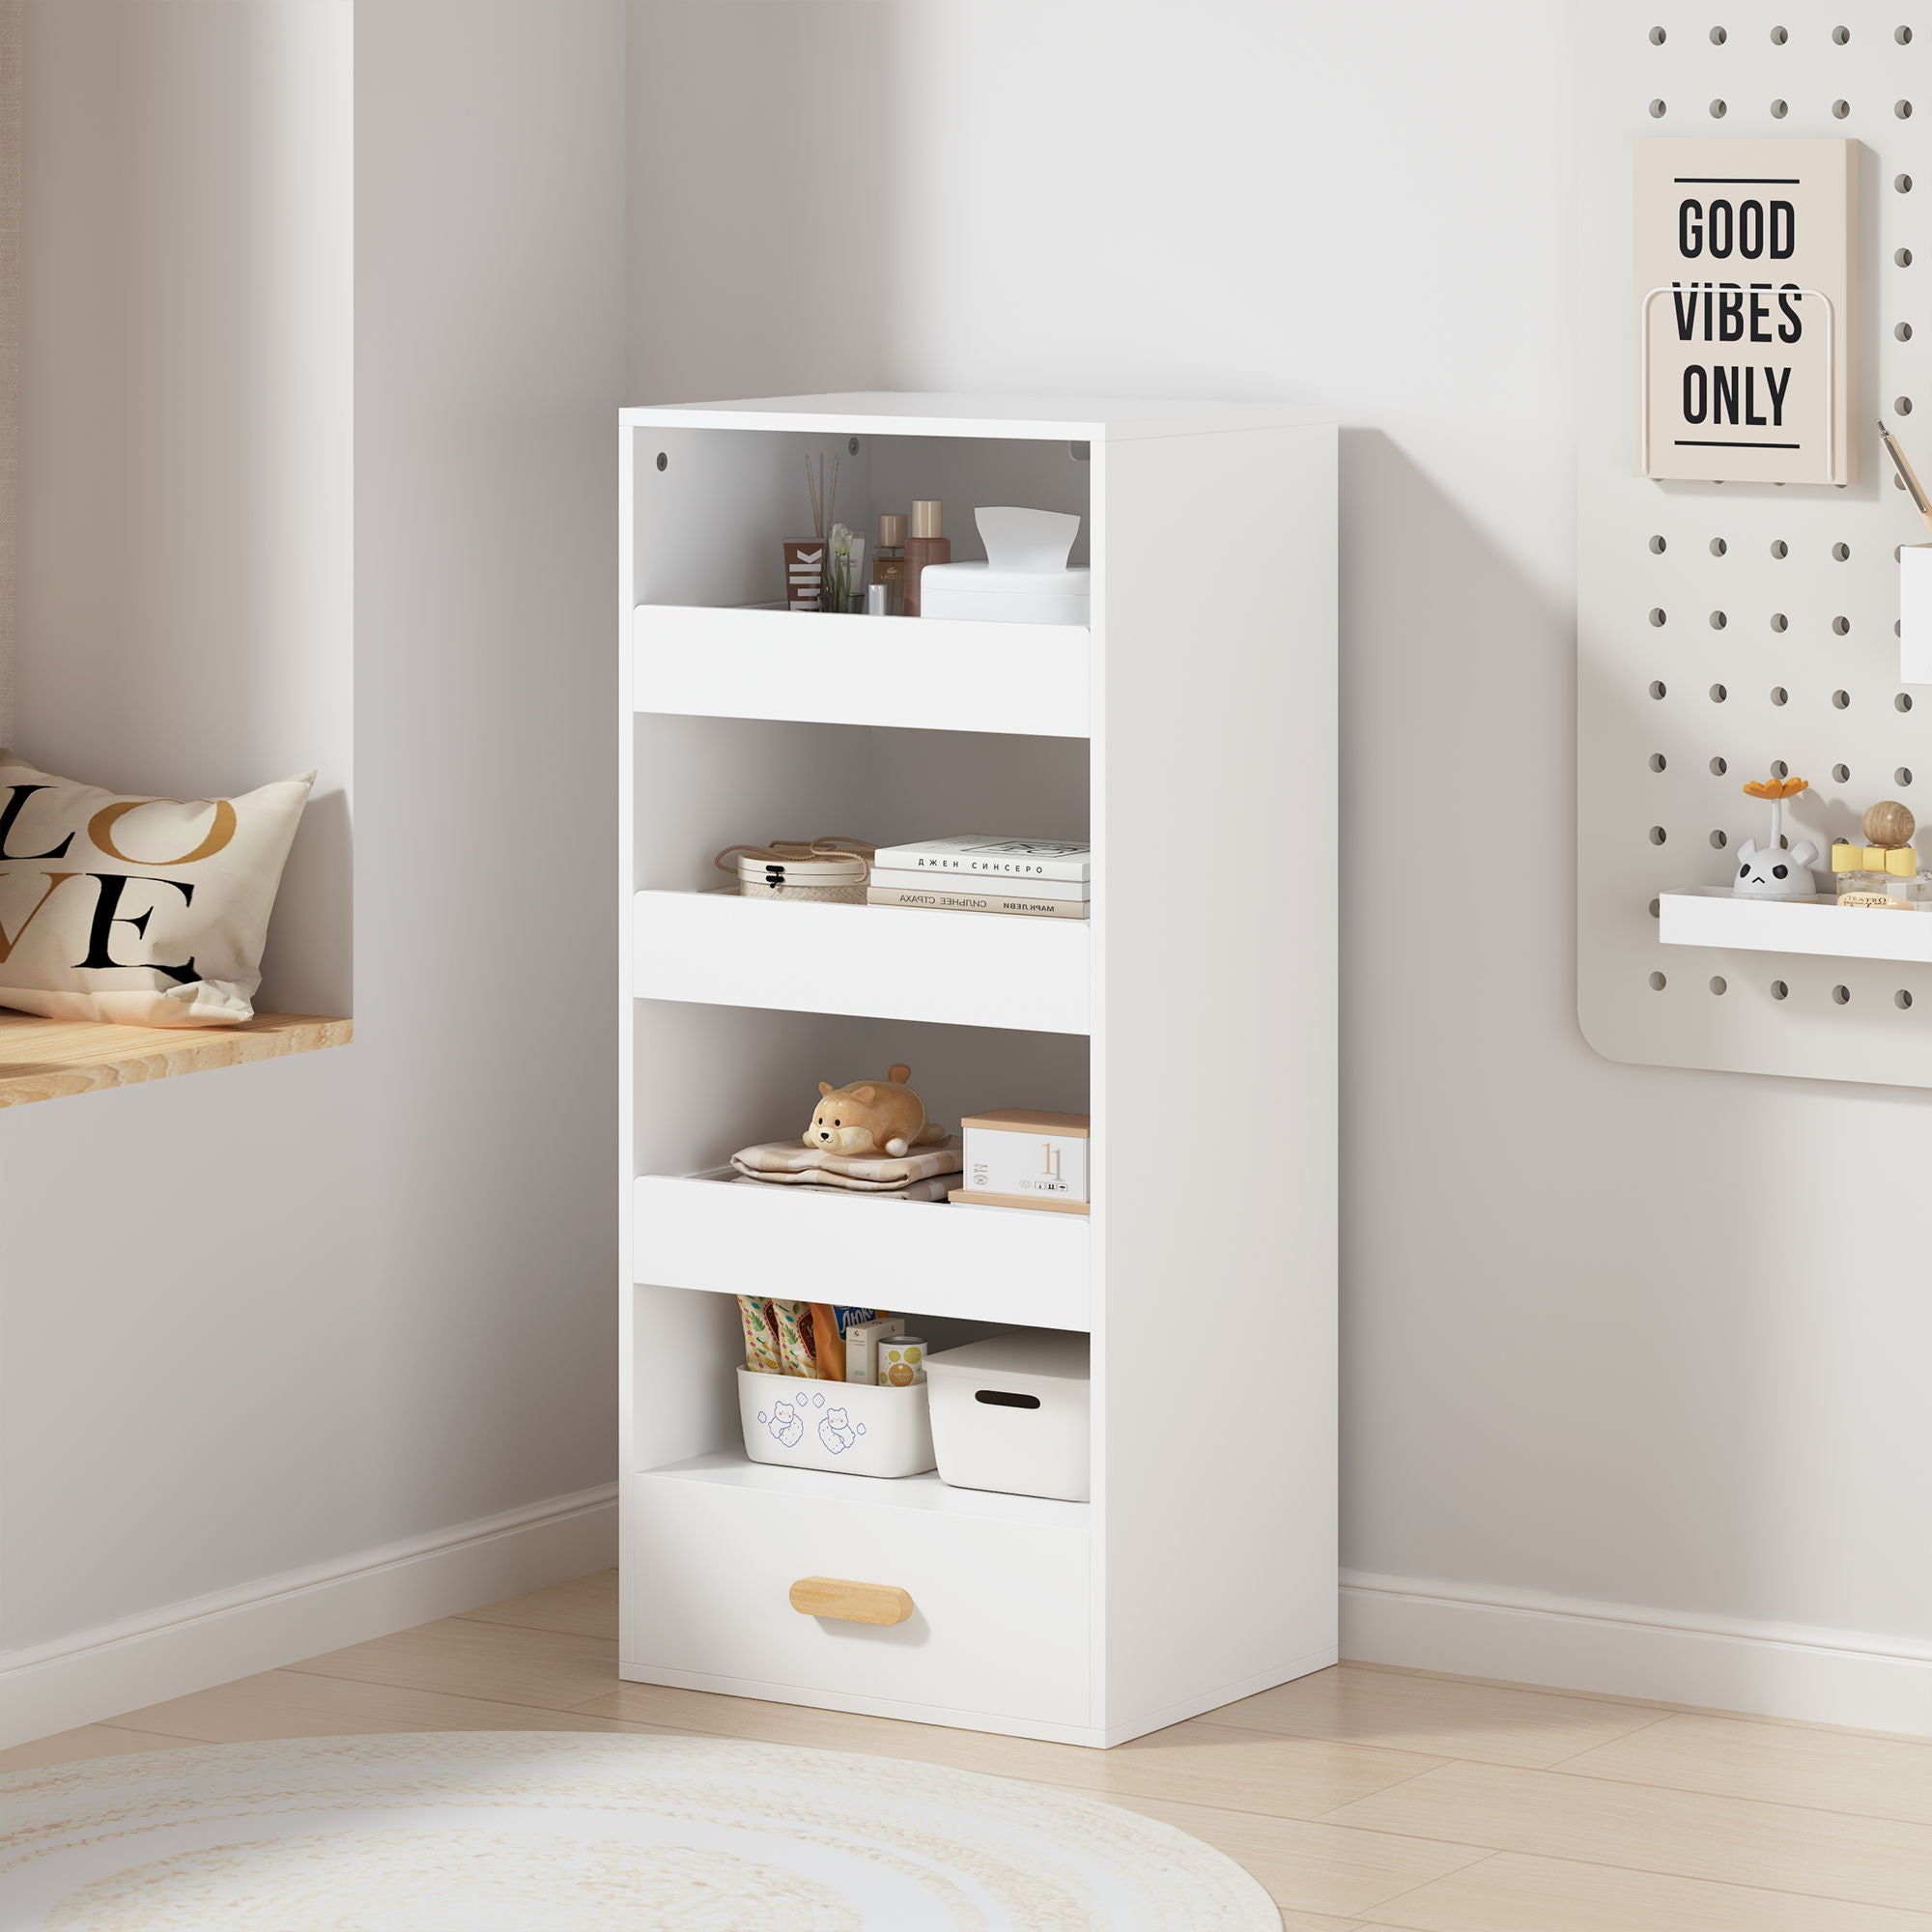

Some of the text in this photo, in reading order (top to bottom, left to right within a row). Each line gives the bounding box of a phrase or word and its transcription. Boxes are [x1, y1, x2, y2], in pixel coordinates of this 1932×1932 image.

[1679, 198, 1795, 259] GOOD
[1672, 281, 1803, 344] VIBES
[1683, 364, 1792, 426] ONLY
[918, 858, 1043, 873] ДЖЕН СИНСЕРО
